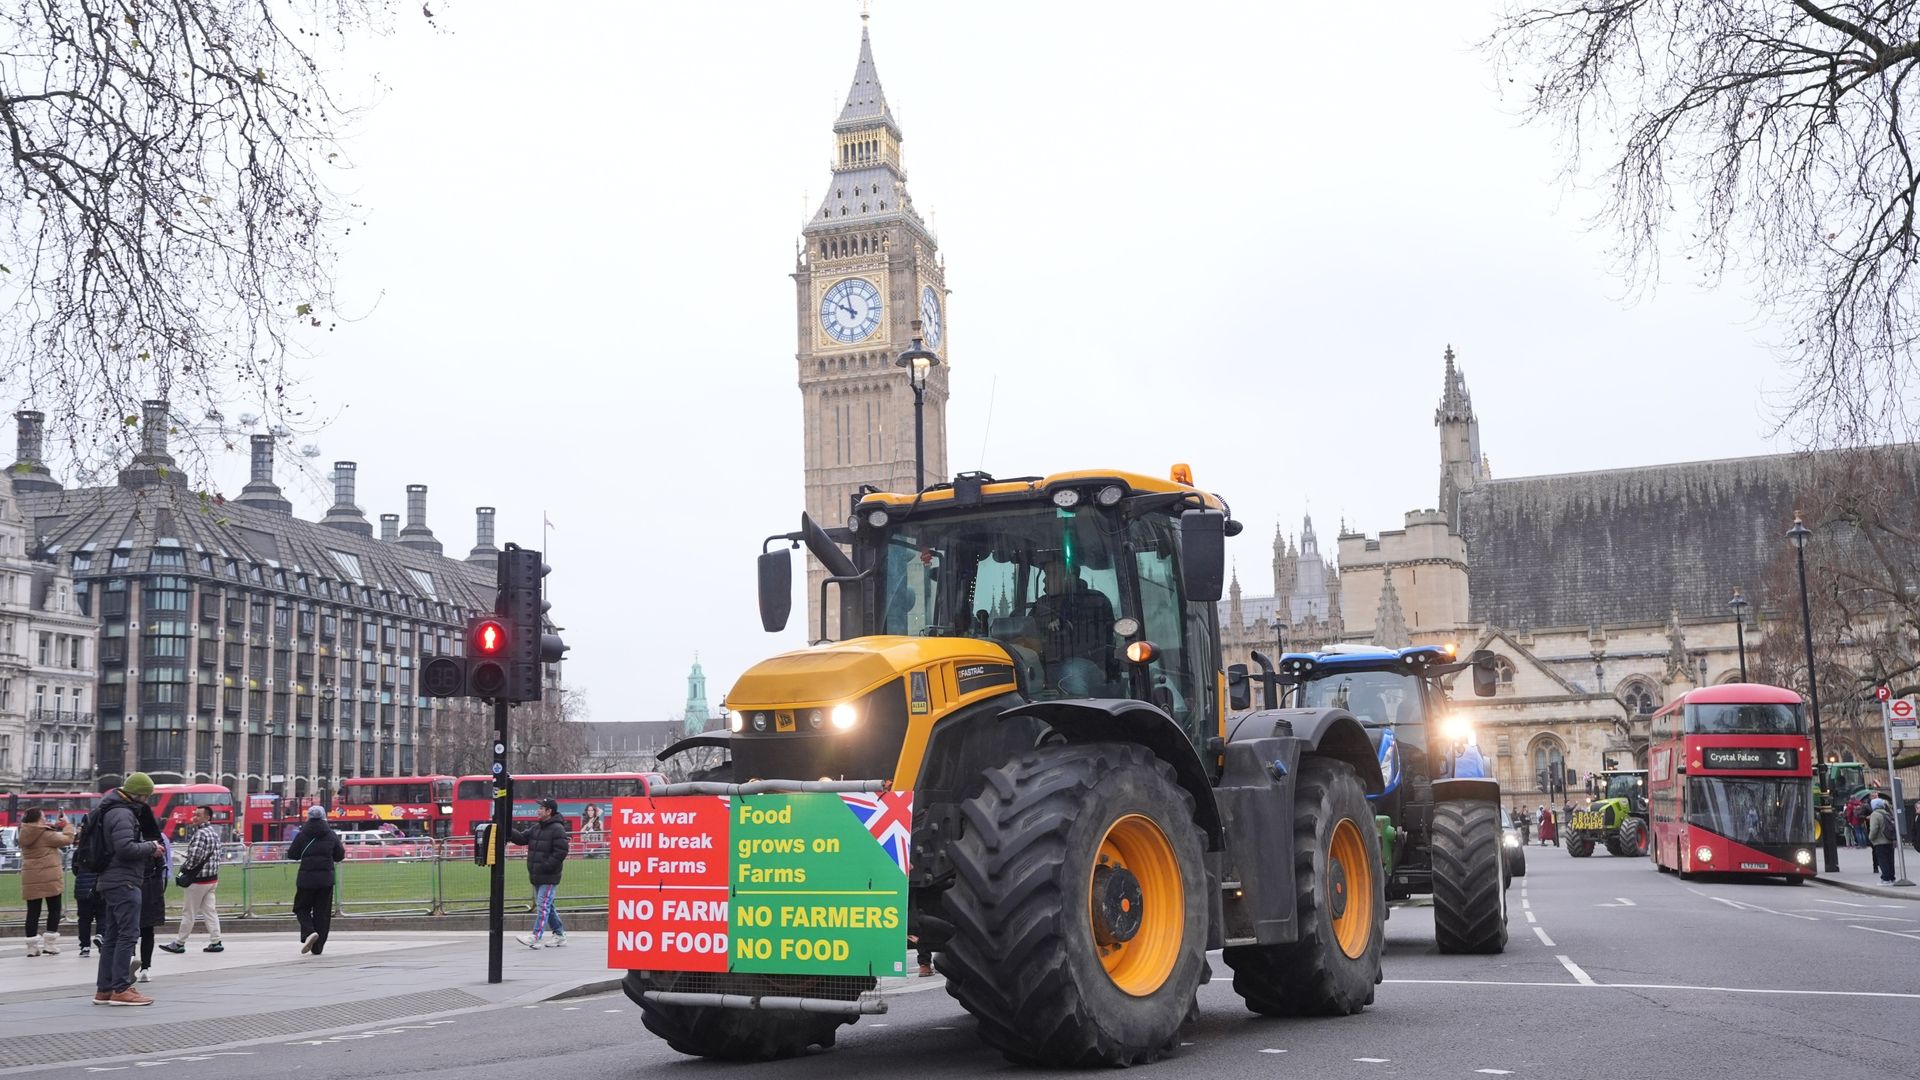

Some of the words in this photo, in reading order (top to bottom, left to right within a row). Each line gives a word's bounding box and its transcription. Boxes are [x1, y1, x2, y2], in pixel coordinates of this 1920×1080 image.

[960, 666, 984, 677] FASTRAC
[1878, 689, 1887, 699] P
[1710, 753, 1736, 763] Crystal
[1737, 754, 1760, 762] Palace
[1776, 751, 1786, 765] 3
[620, 808, 655, 825] Tax
[660, 812, 697, 825] war
[739, 804, 792, 825] Food
[619, 832, 652, 849] will
[658, 832, 713, 849] break
[738, 838, 805, 859] grows
[812, 838, 840, 853] on
[618, 860, 641, 877] up
[647, 857, 707, 874] Farms
[738, 863, 806, 883] Farms
[617, 899, 654, 921] NO
[662, 900, 729, 922] FARM
[737, 905, 773, 927] NO
[780, 906, 899, 929] FARMERS
[617, 930, 653, 952] NO
[661, 931, 729, 954] FOOD
[737, 938, 772, 960] NO
[780, 939, 849, 961] FOOD
